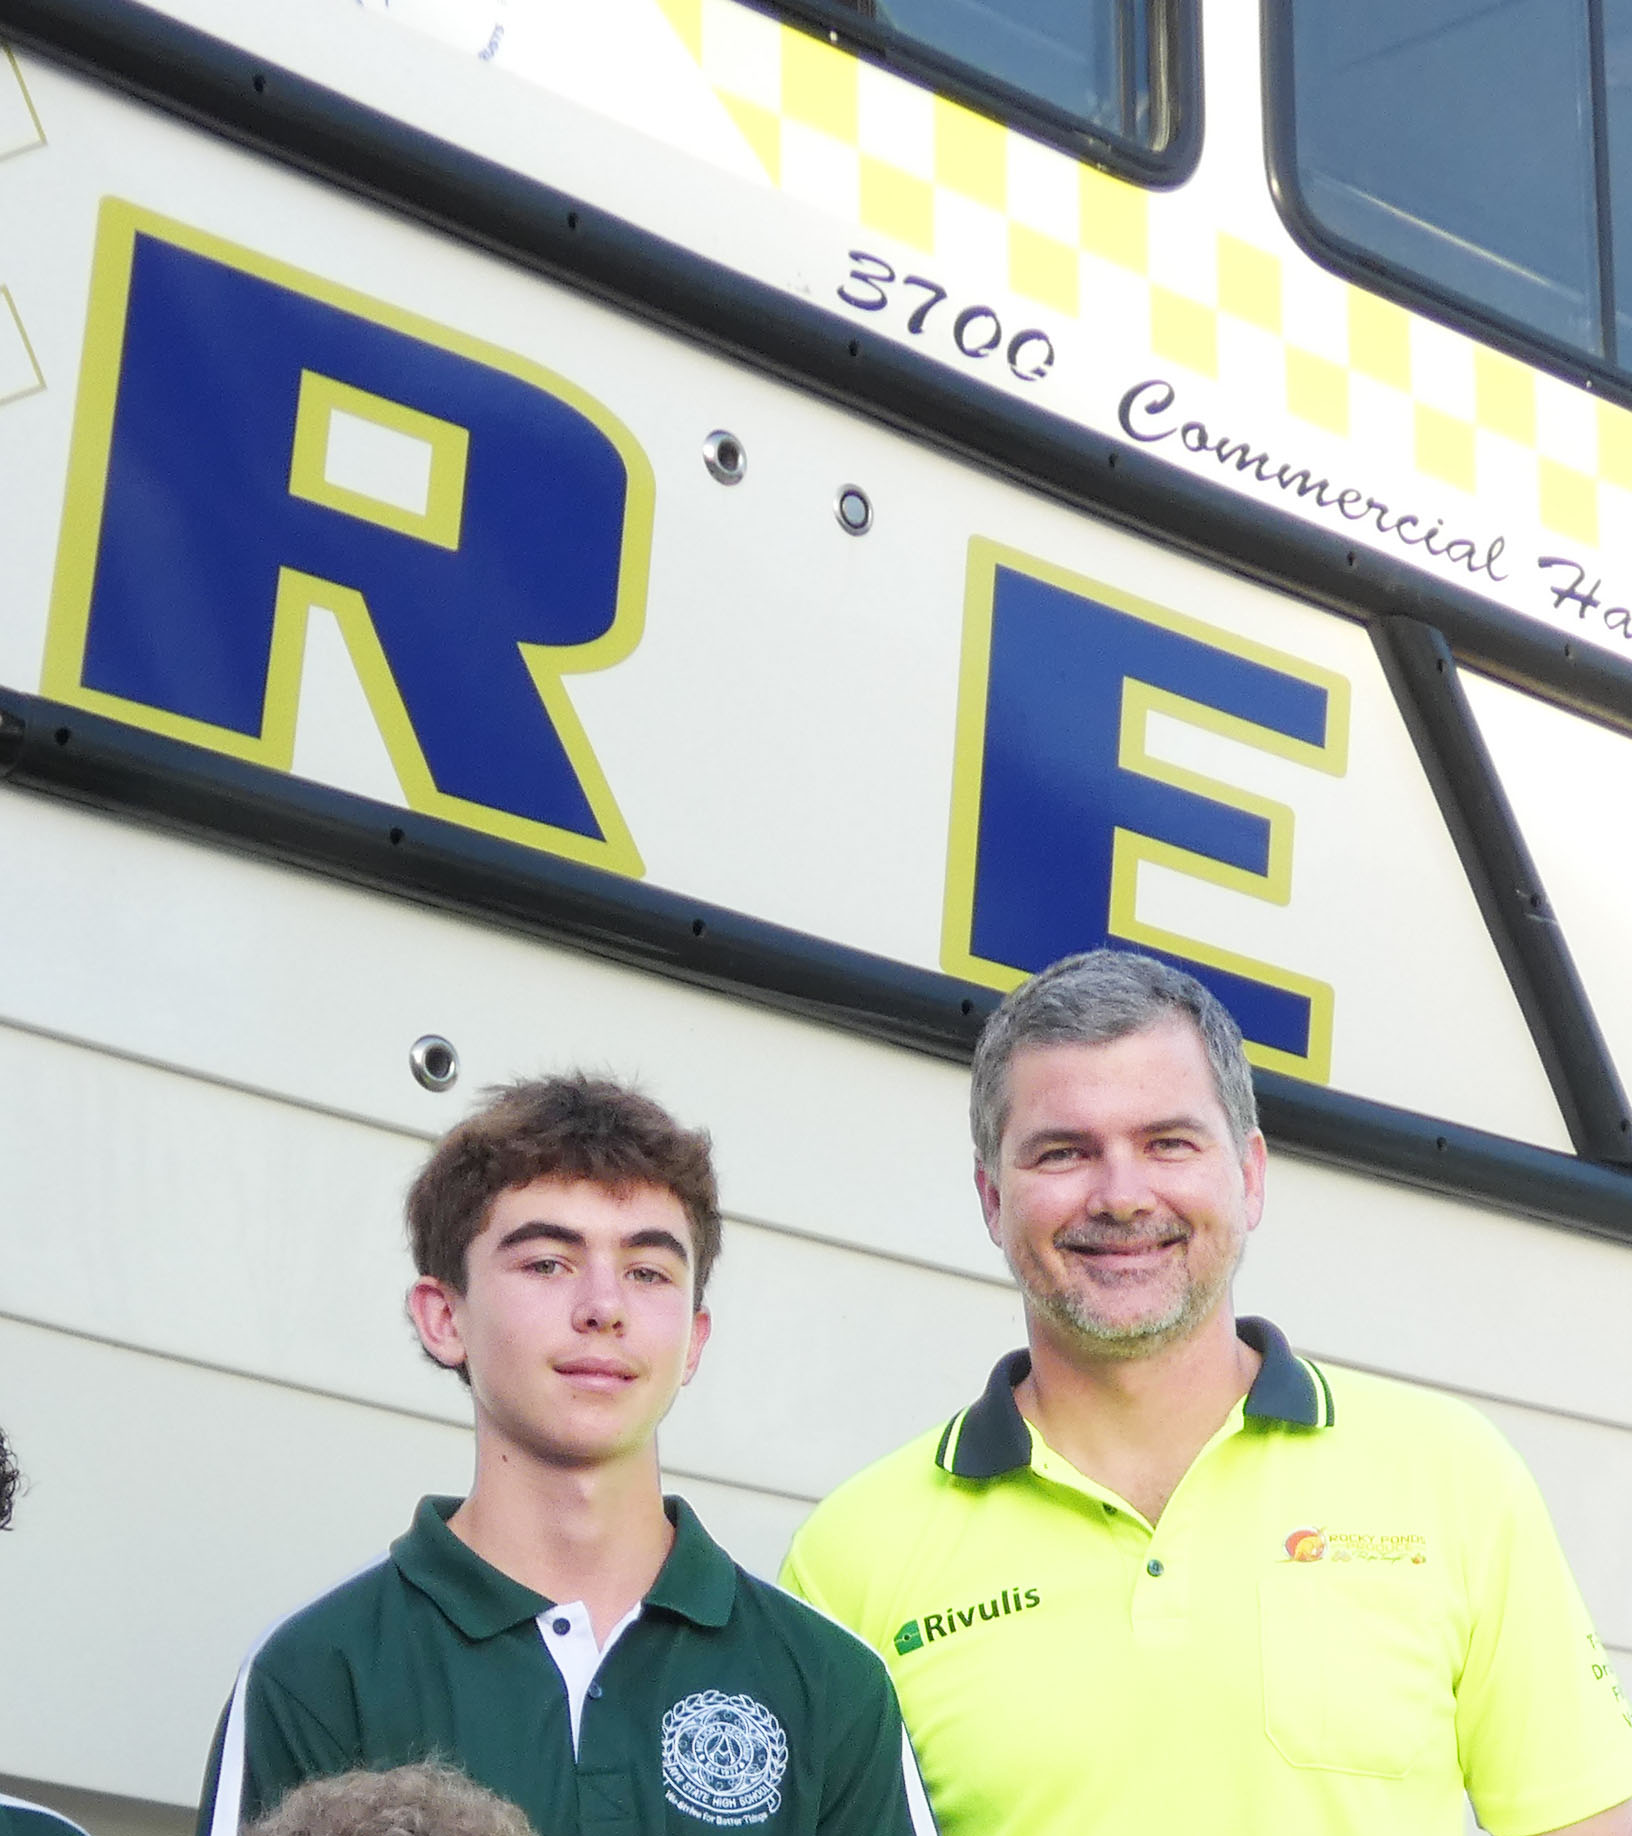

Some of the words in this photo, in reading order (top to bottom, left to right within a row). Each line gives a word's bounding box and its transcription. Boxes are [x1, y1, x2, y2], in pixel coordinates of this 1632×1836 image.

[835, 249, 1058, 384] 3700
[1116, 377, 1512, 583] Commercial
[923, 1586, 1041, 1644] Rivulis
[682, 1781, 709, 1804] STATE
[712, 1796, 737, 1809] HIGH
